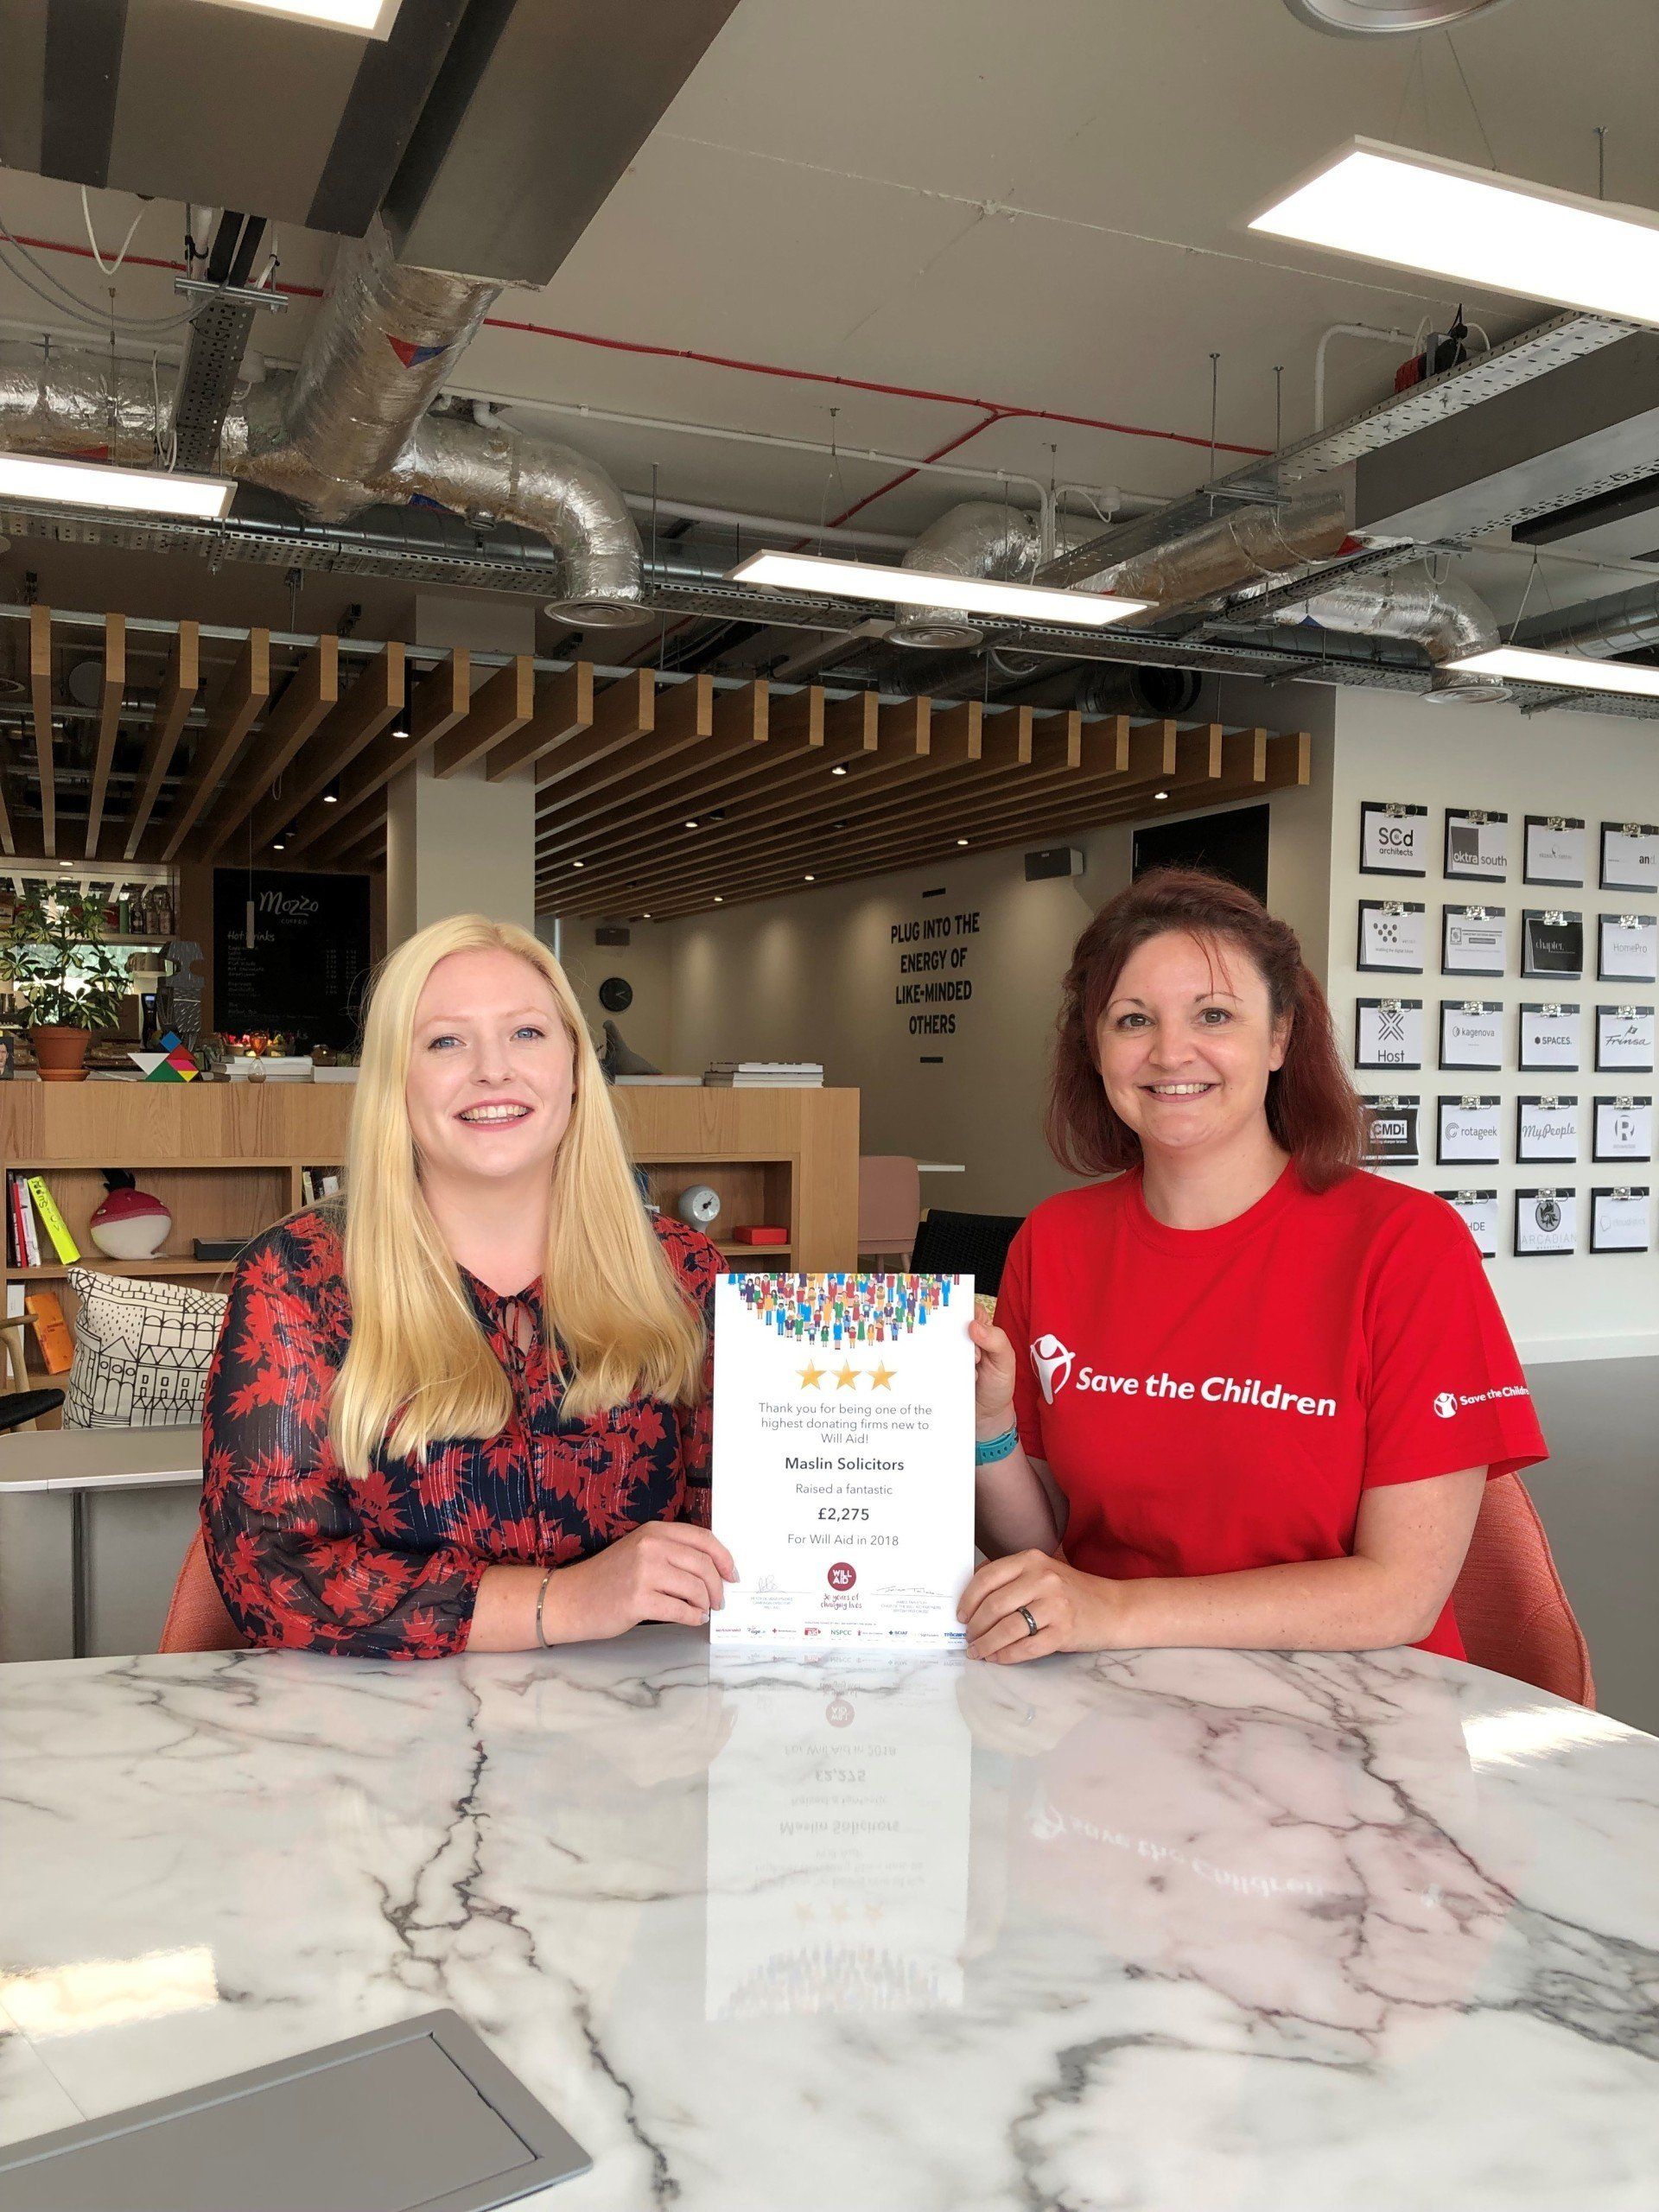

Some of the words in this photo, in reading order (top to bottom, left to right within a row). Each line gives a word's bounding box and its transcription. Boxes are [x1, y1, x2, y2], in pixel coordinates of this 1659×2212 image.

[1378, 827, 1414, 847] SCd
[1379, 847, 1414, 856] architects
[1453, 850, 1478, 864] oktra
[1480, 855, 1508, 867] south
[258, 890, 319, 917] Mozzo
[891, 922, 920, 944] PLUG
[923, 916, 951, 940] INTO
[955, 912, 981, 935] THE
[246, 931, 276, 942] rinks
[1613, 943, 1648, 954] HomePro
[900, 950, 949, 974] ENERGY
[950, 947, 968, 969] OF
[895, 980, 972, 1005] LIKE-MINDED
[908, 1014, 957, 1034] OTHERS
[1461, 1028, 1495, 1039] kagenova
[1377, 1049, 1405, 1063] Host
[1372, 1123, 1405, 1135] CMDi
[1461, 1126, 1497, 1140] rotageek
[1522, 1122, 1576, 1141] MyPeople
[1076, 1367, 1150, 1395] Save
[1146, 1372, 1195, 1400] the
[1201, 1376, 1337, 1417] Children
[1459, 1394, 1487, 1406] Save
[1487, 1389, 1502, 1400] the
[759, 1402, 793, 1414] Thank
[796, 1405, 818, 1416] you
[820, 1402, 836, 1414] for
[839, 1403, 872, 1417] being
[875, 1406, 897, 1415] one
[899, 1404, 915, 1415] of
[917, 1405, 932, 1415] the
[760, 1418, 804, 1430] highest
[806, 1418, 857, 1432] donating
[860, 1418, 888, 1430] firms
[892, 1421, 915, 1430] new
[918, 1420, 929, 1430] to
[821, 1433, 842, 1444] Will
[846, 1433, 869, 1445] Aid!
[785, 1457, 833, 1471] Maslin
[837, 1458, 905, 1471] Solicitors
[796, 1484, 833, 1495] Raised
[836, 1485, 843, 1495] a
[846, 1484, 893, 1496] fantastic
[817, 1507, 869, 1522] £2,275
[788, 1534, 806, 1545] For
[809, 1534, 830, 1545] Will
[835, 1535, 854, 1545] Aid
[857, 1535, 867, 1545] in
[870, 1535, 899, 1546] 2018
[832, 1569, 852, 1578] WILL
[832, 1576, 849, 1585] AID
[832, 1593, 850, 1602] years
[851, 1592, 860, 1601] of
[830, 1628, 852, 1637] NSPCC
